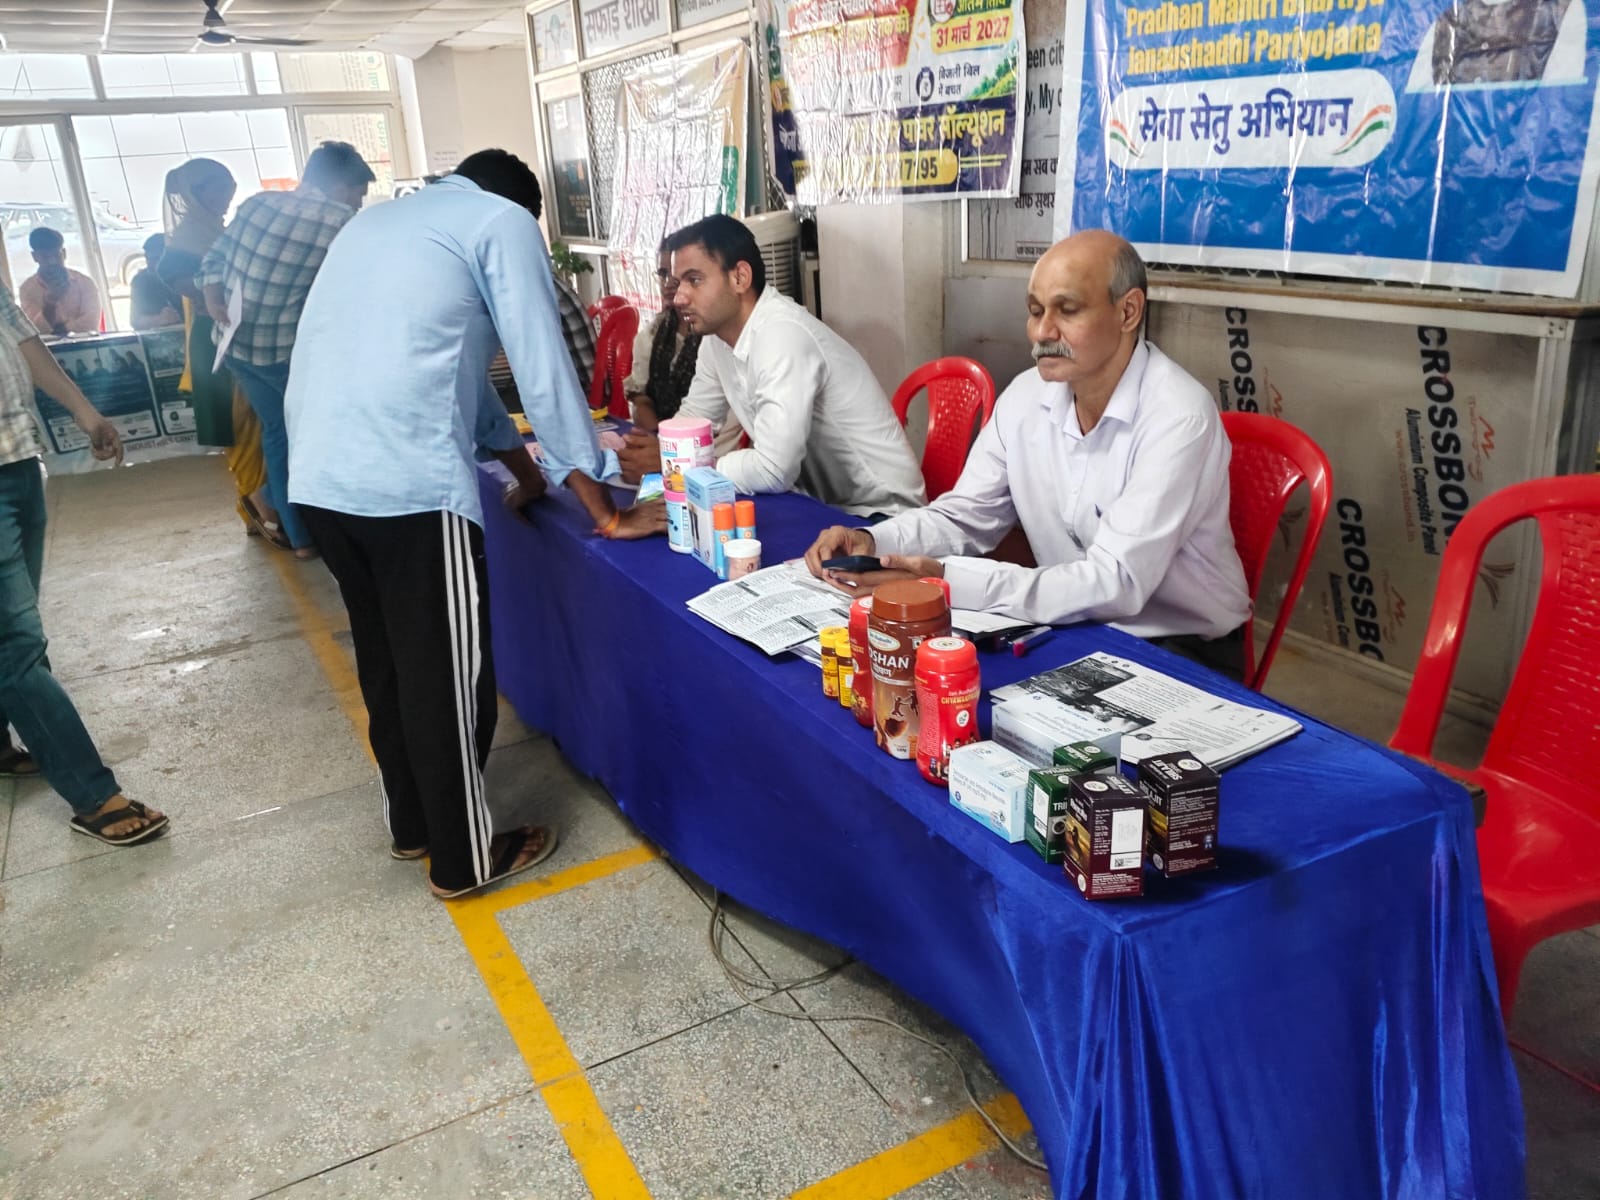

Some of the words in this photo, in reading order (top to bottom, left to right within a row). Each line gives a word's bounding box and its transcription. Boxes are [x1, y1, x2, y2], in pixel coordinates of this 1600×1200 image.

[936, 27, 949, 48] 31
[952, 17, 972, 44] मार्च
[976, 16, 1010, 41] 2027
[1126, 1, 1203, 38] Pradhan
[1127, 32, 1249, 75] Janaushadhi
[1255, 22, 1382, 63] Pariyojana
[1039, 83, 1054, 115] My
[902, 115, 936, 144] पावर
[938, 104, 1006, 148] सॉल्यूशन
[1139, 97, 1185, 142] सेवा
[1191, 92, 1233, 154] सेतु
[1238, 87, 1353, 138] अभियान
